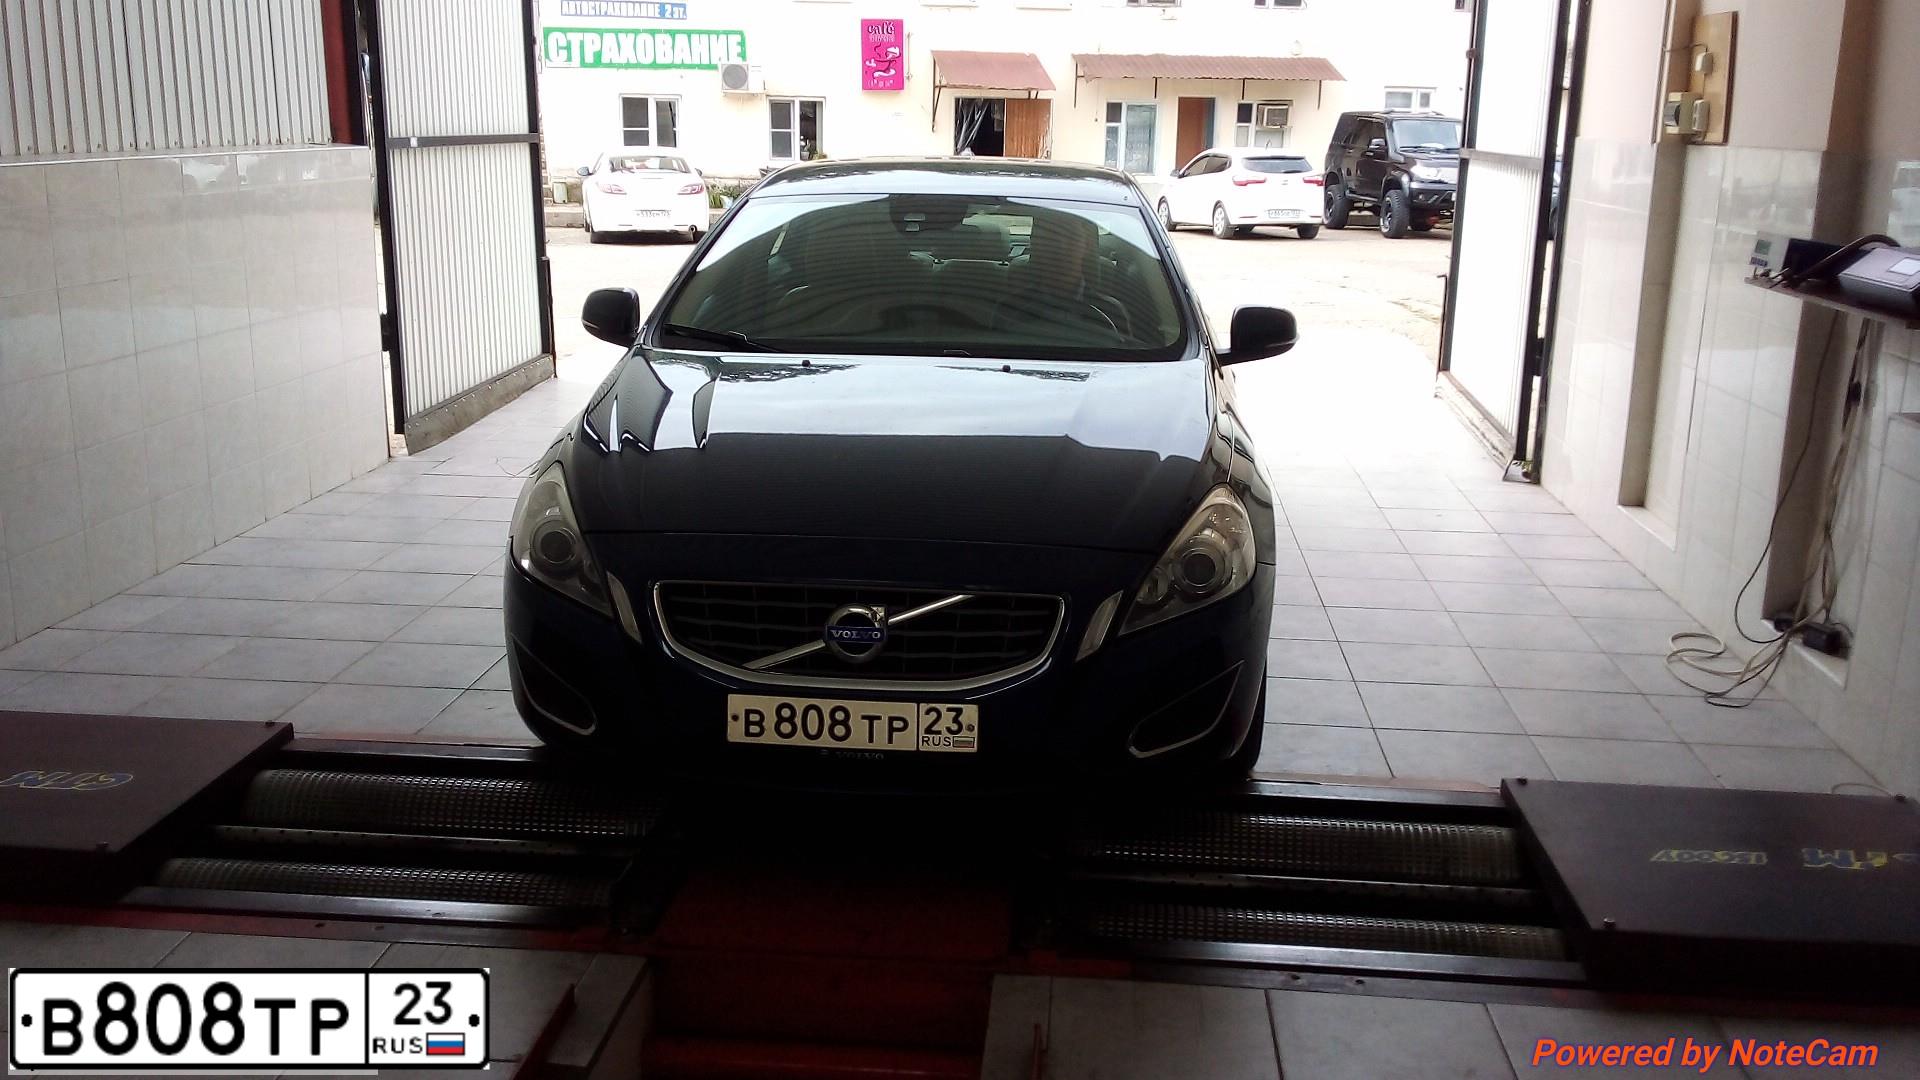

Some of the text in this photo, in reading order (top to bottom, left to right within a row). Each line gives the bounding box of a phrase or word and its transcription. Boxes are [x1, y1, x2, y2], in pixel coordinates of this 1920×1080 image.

[547, 31, 743, 64] СТРАХОВАНИЕ
[829, 629, 881, 640] VOLVO
[923, 706, 964, 735] 23
[921, 735, 952, 747] RUS
